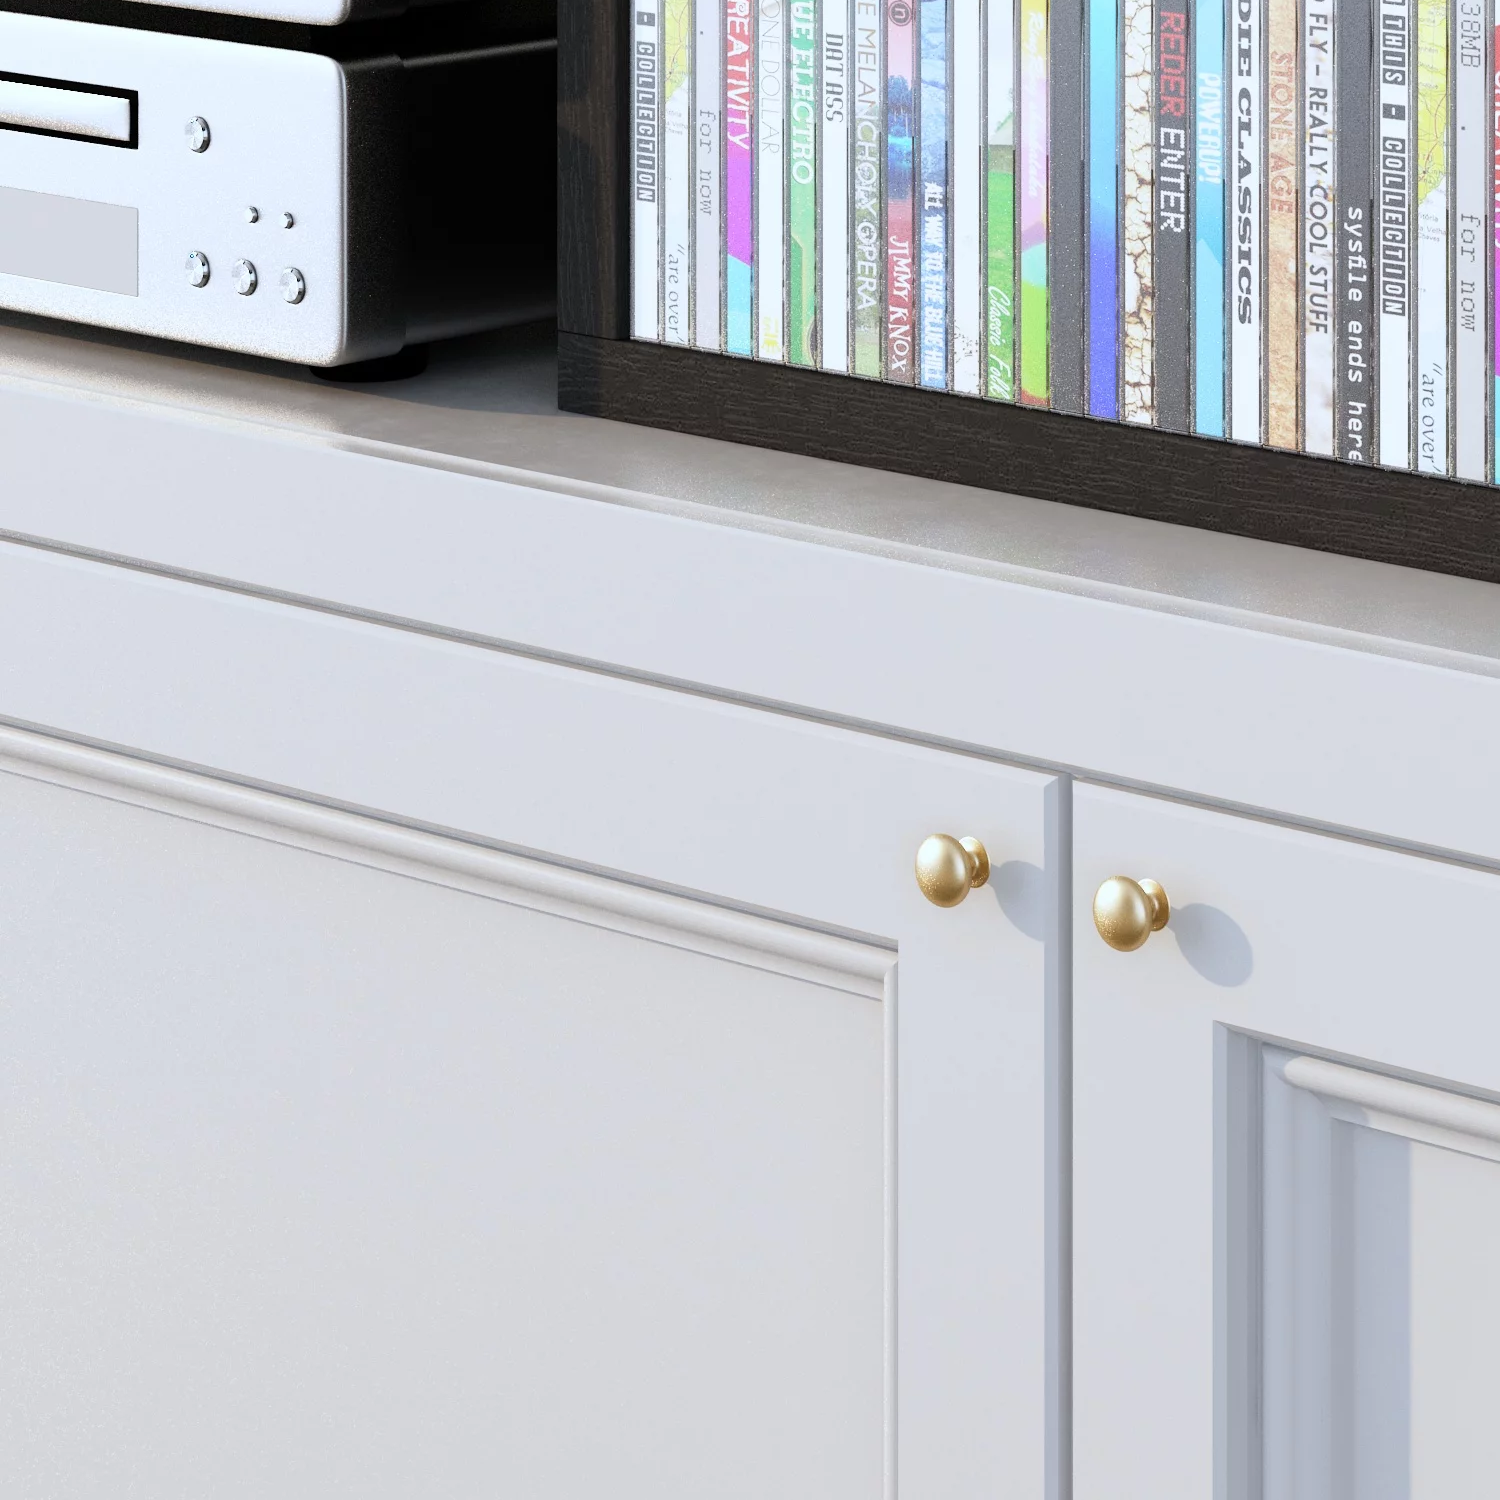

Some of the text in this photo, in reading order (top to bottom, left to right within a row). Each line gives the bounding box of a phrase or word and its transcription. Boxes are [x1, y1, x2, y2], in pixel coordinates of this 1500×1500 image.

[826, 33, 843, 123] DAT ASS
[1309, 13, 1328, 54] FLY
[1383, 14, 1405, 86] THIS
[636, 41, 655, 203] COLLECTION
[700, 110, 716, 154] for
[761, 60, 780, 154] DOLLAR
[792, 47, 814, 185] ELECTRO
[857, 27, 877, 216] MELANCHOLY
[1160, 12, 1185, 232] REDER ENTER
[1198, 72, 1221, 184] POWERUP!
[1270, 51, 1294, 214] STONE AGE
[1309, 87, 1328, 176] REALLY
[700, 169, 712, 216] now
[924, 182, 943, 210] ALL
[1238, 88, 1251, 324] CLASSICS
[1309, 185, 1328, 253] COOL
[1383, 137, 1405, 316] COLLECTION
[857, 221, 877, 310] OPERA
[925, 251, 943, 271] TO
[1344, 207, 1367, 302] sysfile
[1461, 213, 1481, 262] for
[888, 236, 911, 373] JIMMY KNOX
[922, 275, 943, 304] THE
[1309, 265, 1328, 334] STUFF
[1461, 280, 1475, 332] now
[988, 286, 1011, 399] Classic Folk
[1348, 320, 1366, 383] ends
